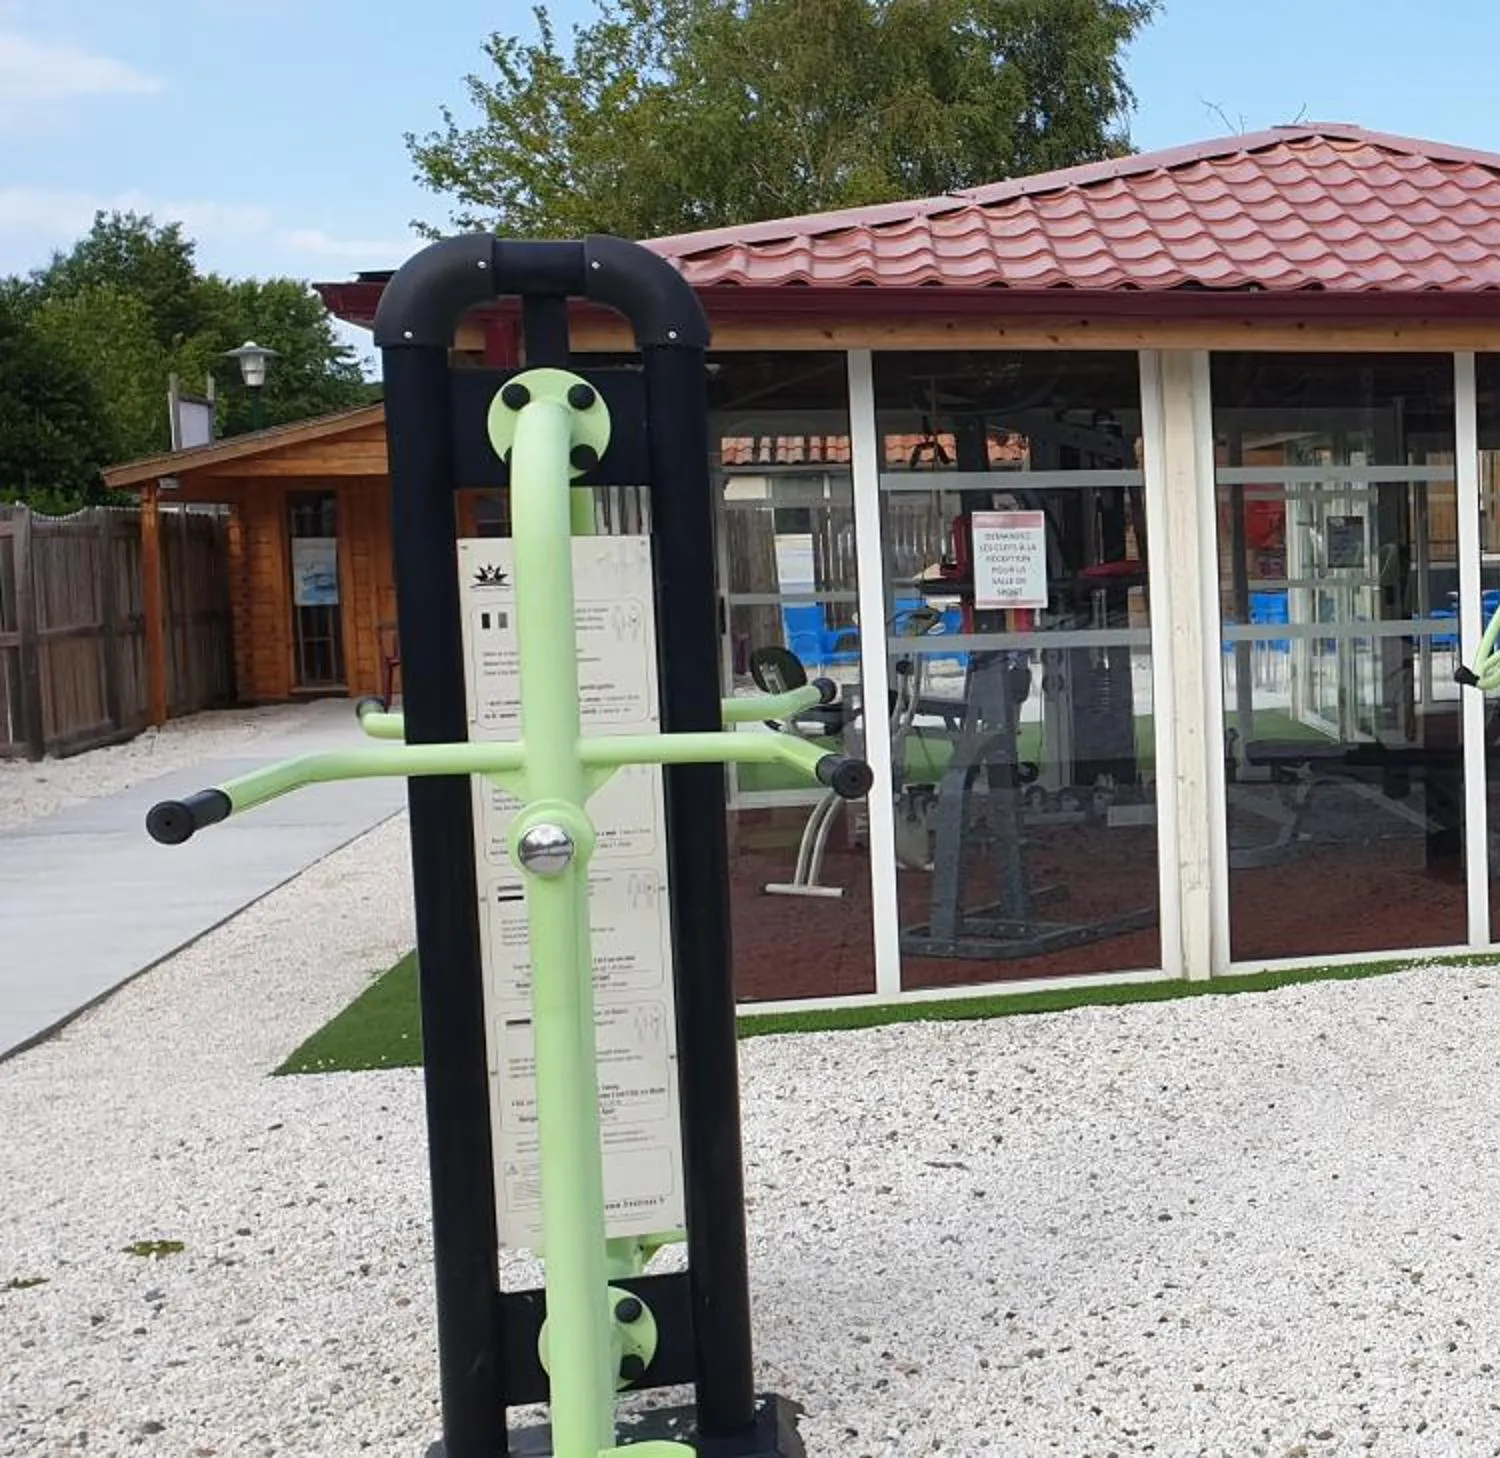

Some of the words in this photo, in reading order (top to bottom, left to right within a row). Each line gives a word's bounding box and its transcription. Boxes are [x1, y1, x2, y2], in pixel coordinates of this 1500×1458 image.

[979, 544, 993, 552] LES
[992, 566, 1014, 574] POUR
[992, 577, 1013, 585] SALLE
